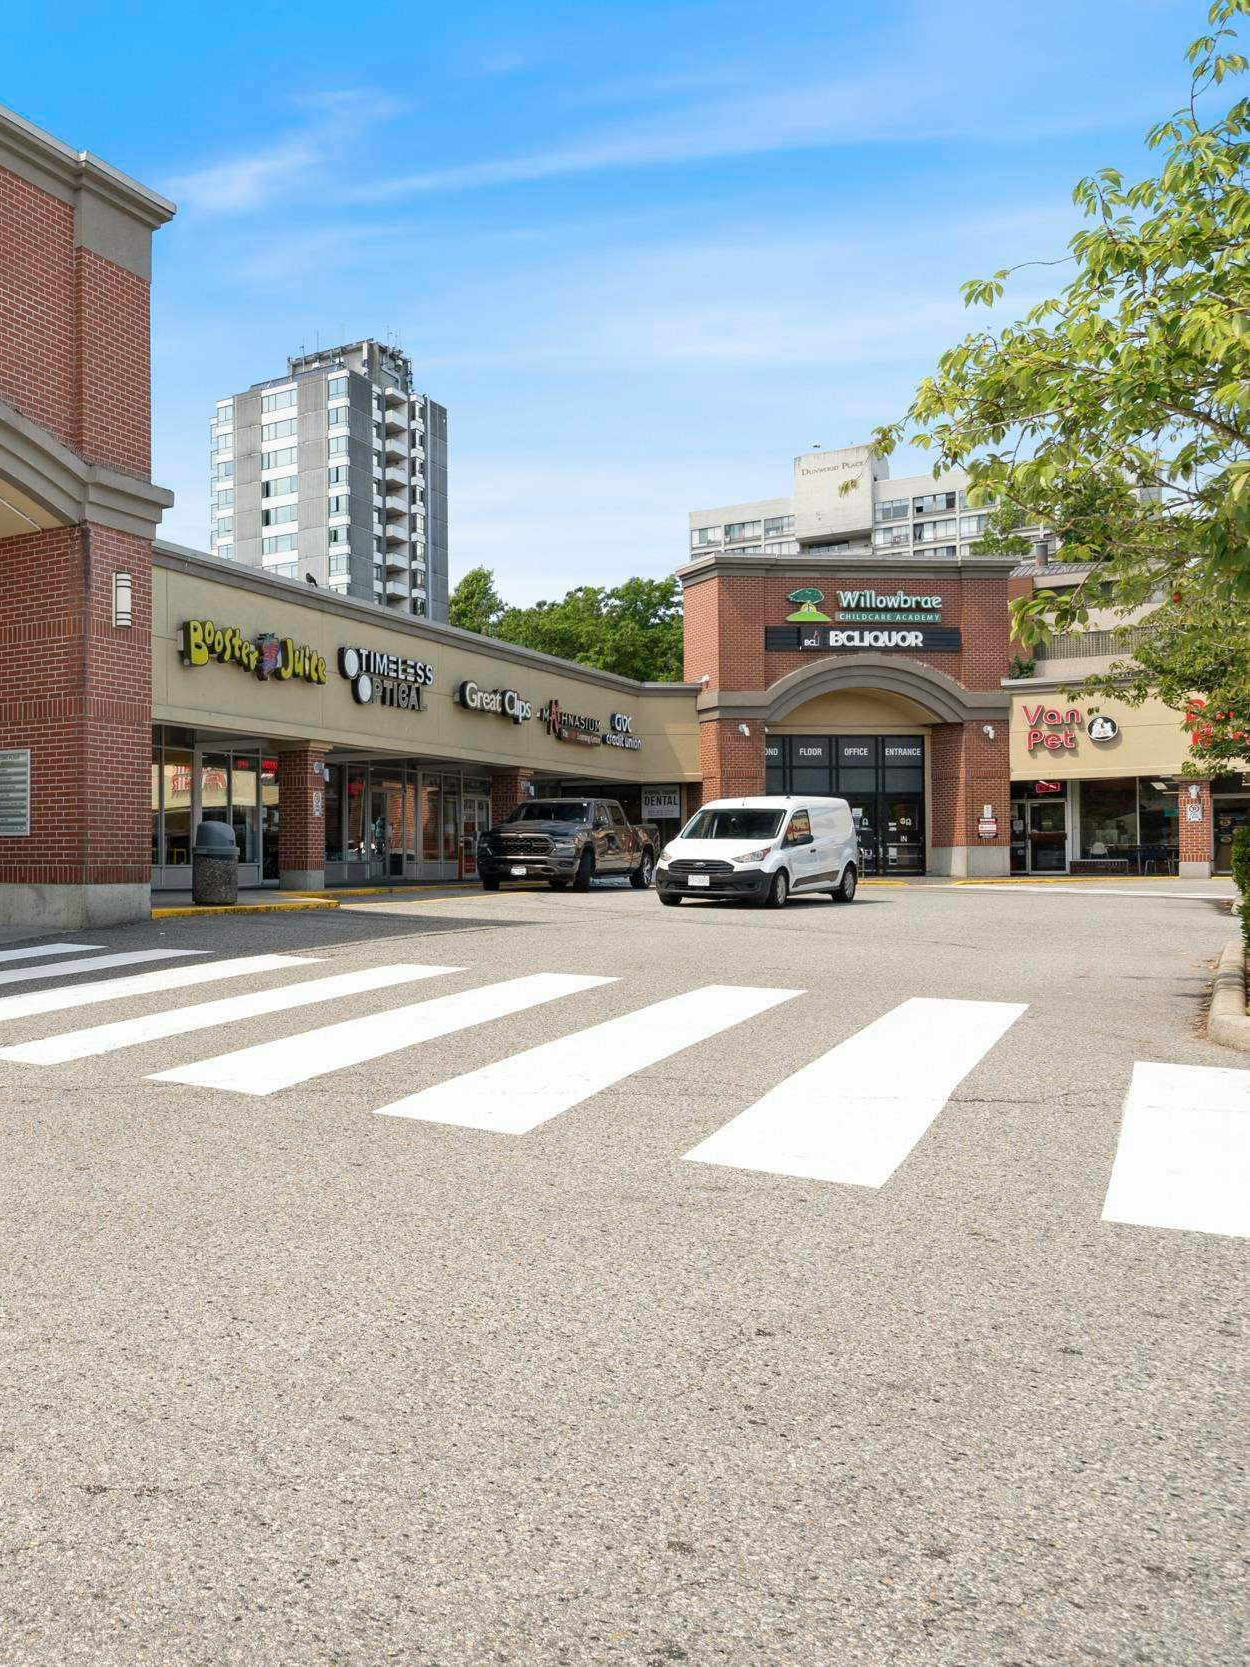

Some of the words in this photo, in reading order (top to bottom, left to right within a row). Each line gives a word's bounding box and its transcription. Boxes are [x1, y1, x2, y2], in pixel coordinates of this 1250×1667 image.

[837, 590, 943, 609] Willowbrae
[839, 613, 892, 621] CHILDCARE
[895, 613, 940, 621] ACADEMY
[829, 630, 924, 647] BCLIQUOR
[184, 620, 259, 672] Booster
[277, 638, 327, 684] Juice
[360, 648, 434, 686] TIMELESS
[463, 681, 502, 712] Great
[503, 690, 532, 723] Clips
[1022, 705, 1082, 725] Van
[606, 734, 624, 747] credit
[625, 737, 642, 749] union
[1027, 728, 1076, 750] Pet
[799, 748, 822, 756] FLOOR
[844, 748, 868, 756] OFFICE
[885, 748, 921, 756] ENTRANCE
[644, 795, 678, 806] DENTAL
[900, 835, 908, 843] IN
